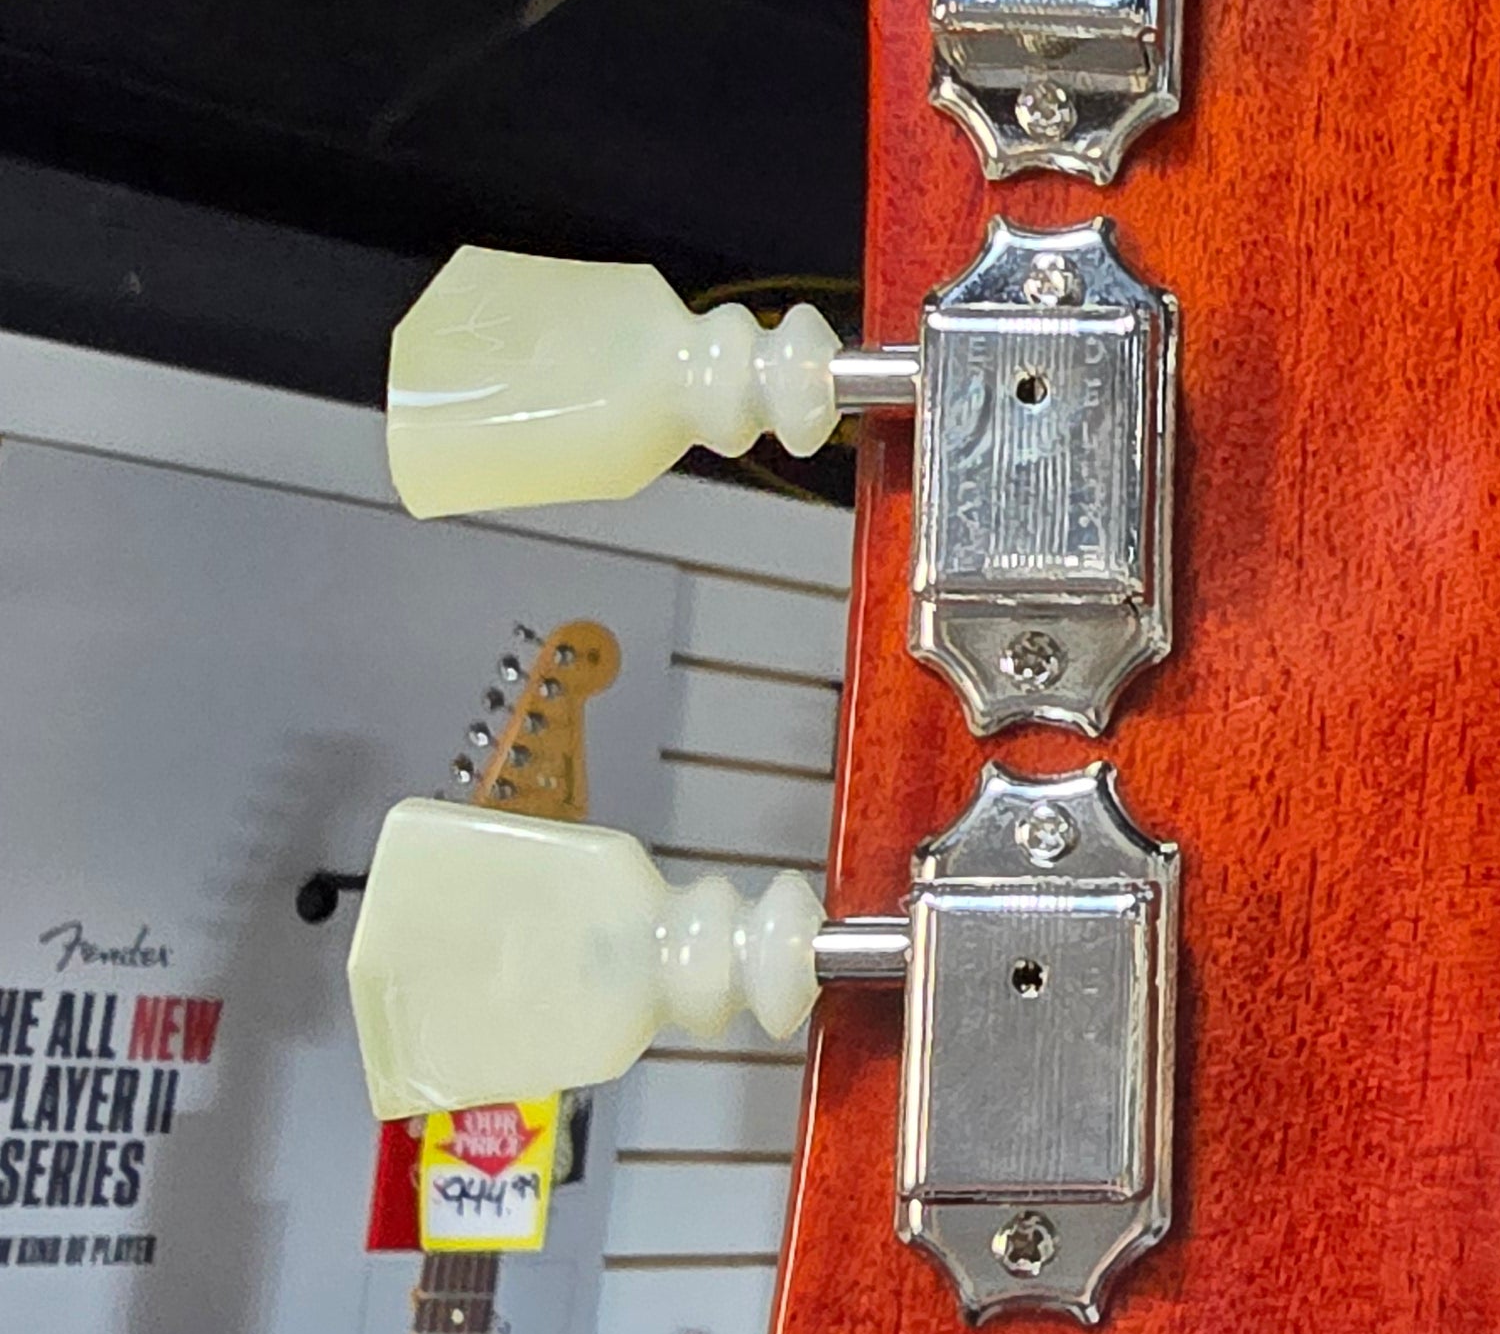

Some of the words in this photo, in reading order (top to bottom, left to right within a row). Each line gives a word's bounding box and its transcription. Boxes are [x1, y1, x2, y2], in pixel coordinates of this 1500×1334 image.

[39, 919, 173, 972] Fender
[0, 988, 43, 1056] HE
[46, 990, 117, 1059] ALL
[127, 994, 224, 1064] NEW
[145, 1069, 180, 1134] II
[0, 1137, 145, 1207] SERIES
